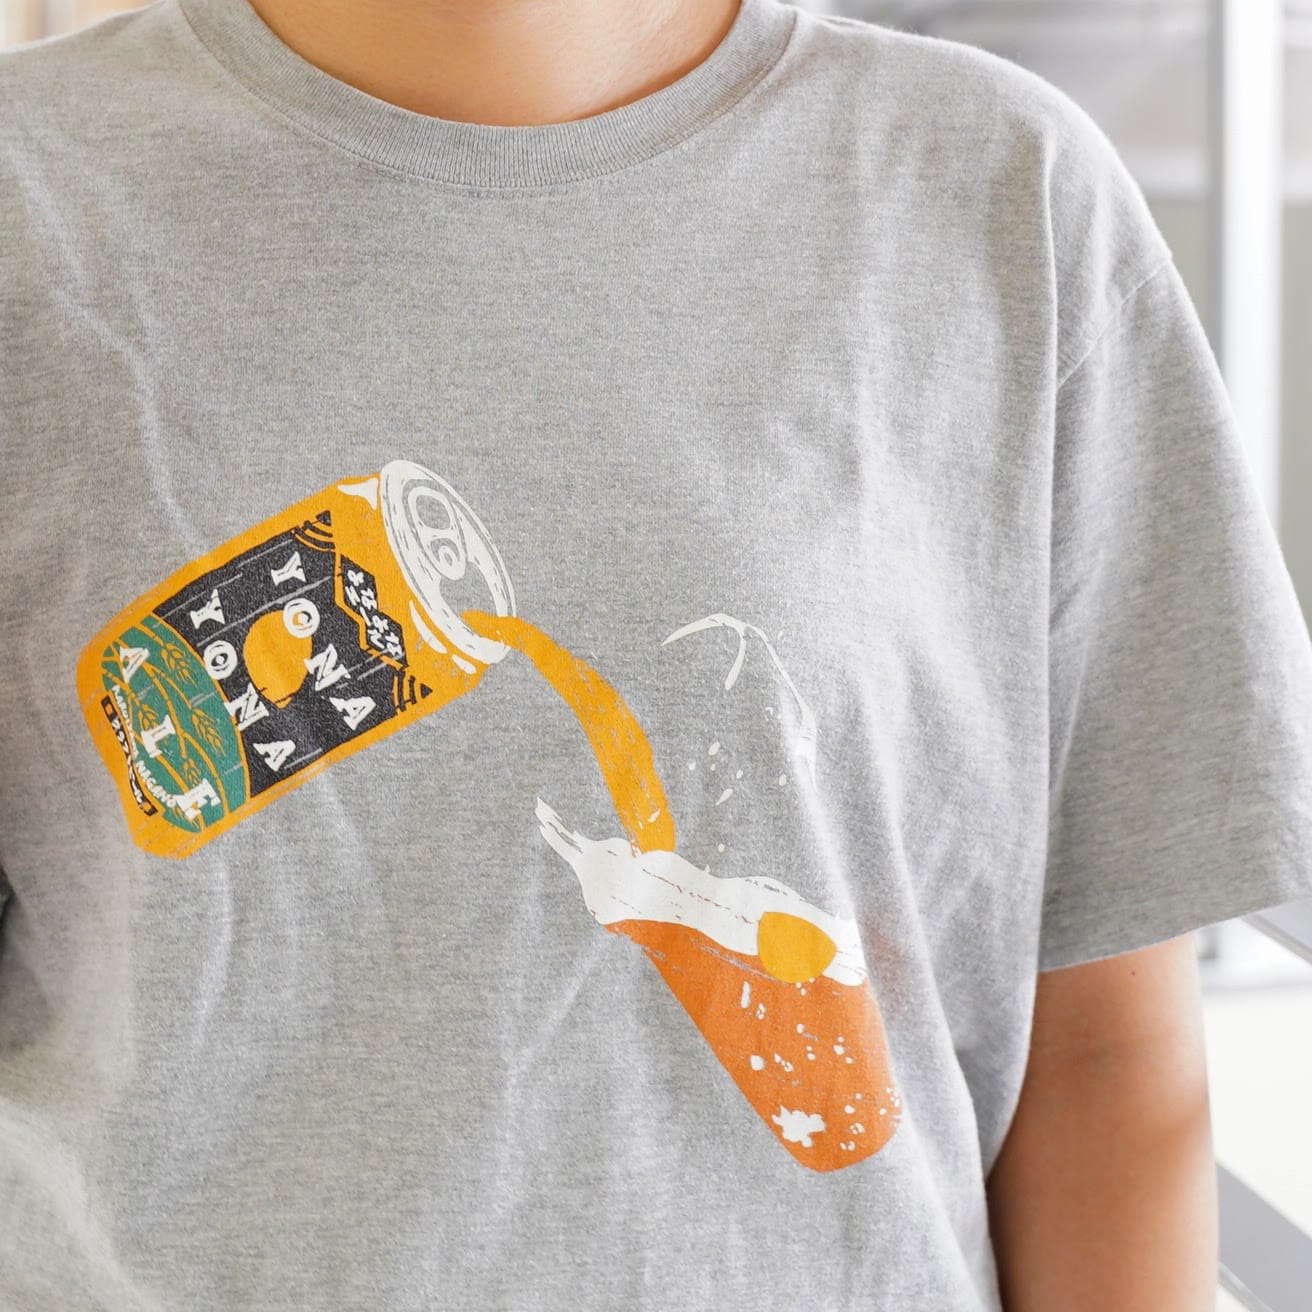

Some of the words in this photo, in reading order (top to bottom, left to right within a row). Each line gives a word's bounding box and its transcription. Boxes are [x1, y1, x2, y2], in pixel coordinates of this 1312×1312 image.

[189, 588, 297, 773] YONA
[270, 551, 377, 731] YONA
[119, 645, 222, 820] ALE
